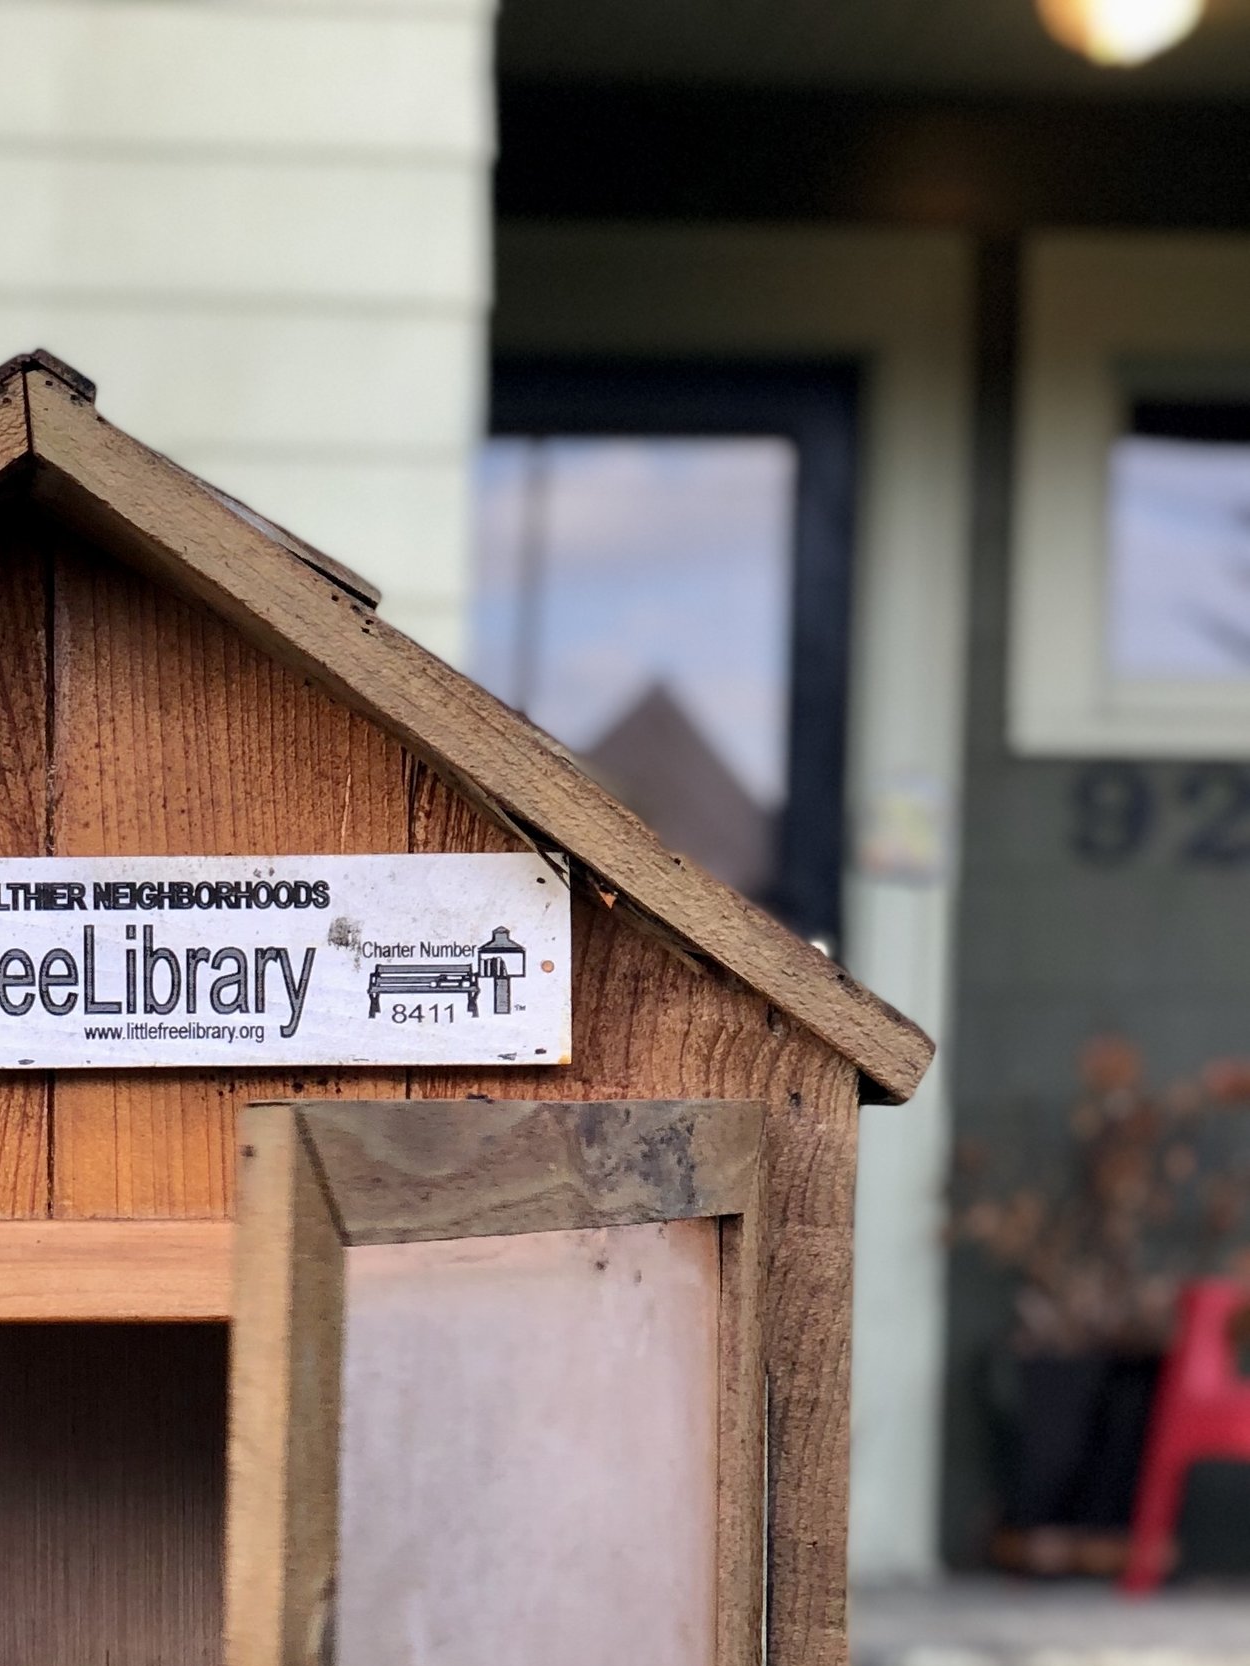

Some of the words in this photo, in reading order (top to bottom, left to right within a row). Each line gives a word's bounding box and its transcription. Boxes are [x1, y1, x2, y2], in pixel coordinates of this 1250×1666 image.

[93, 880, 330, 910] NEIGHBORHOODS
[362, 941, 416, 959] Charter
[419, 941, 478, 959] Number
[391, 1003, 455, 1024] 8411
[84, 1022, 265, 1043] www.littlefreelibrary.org
